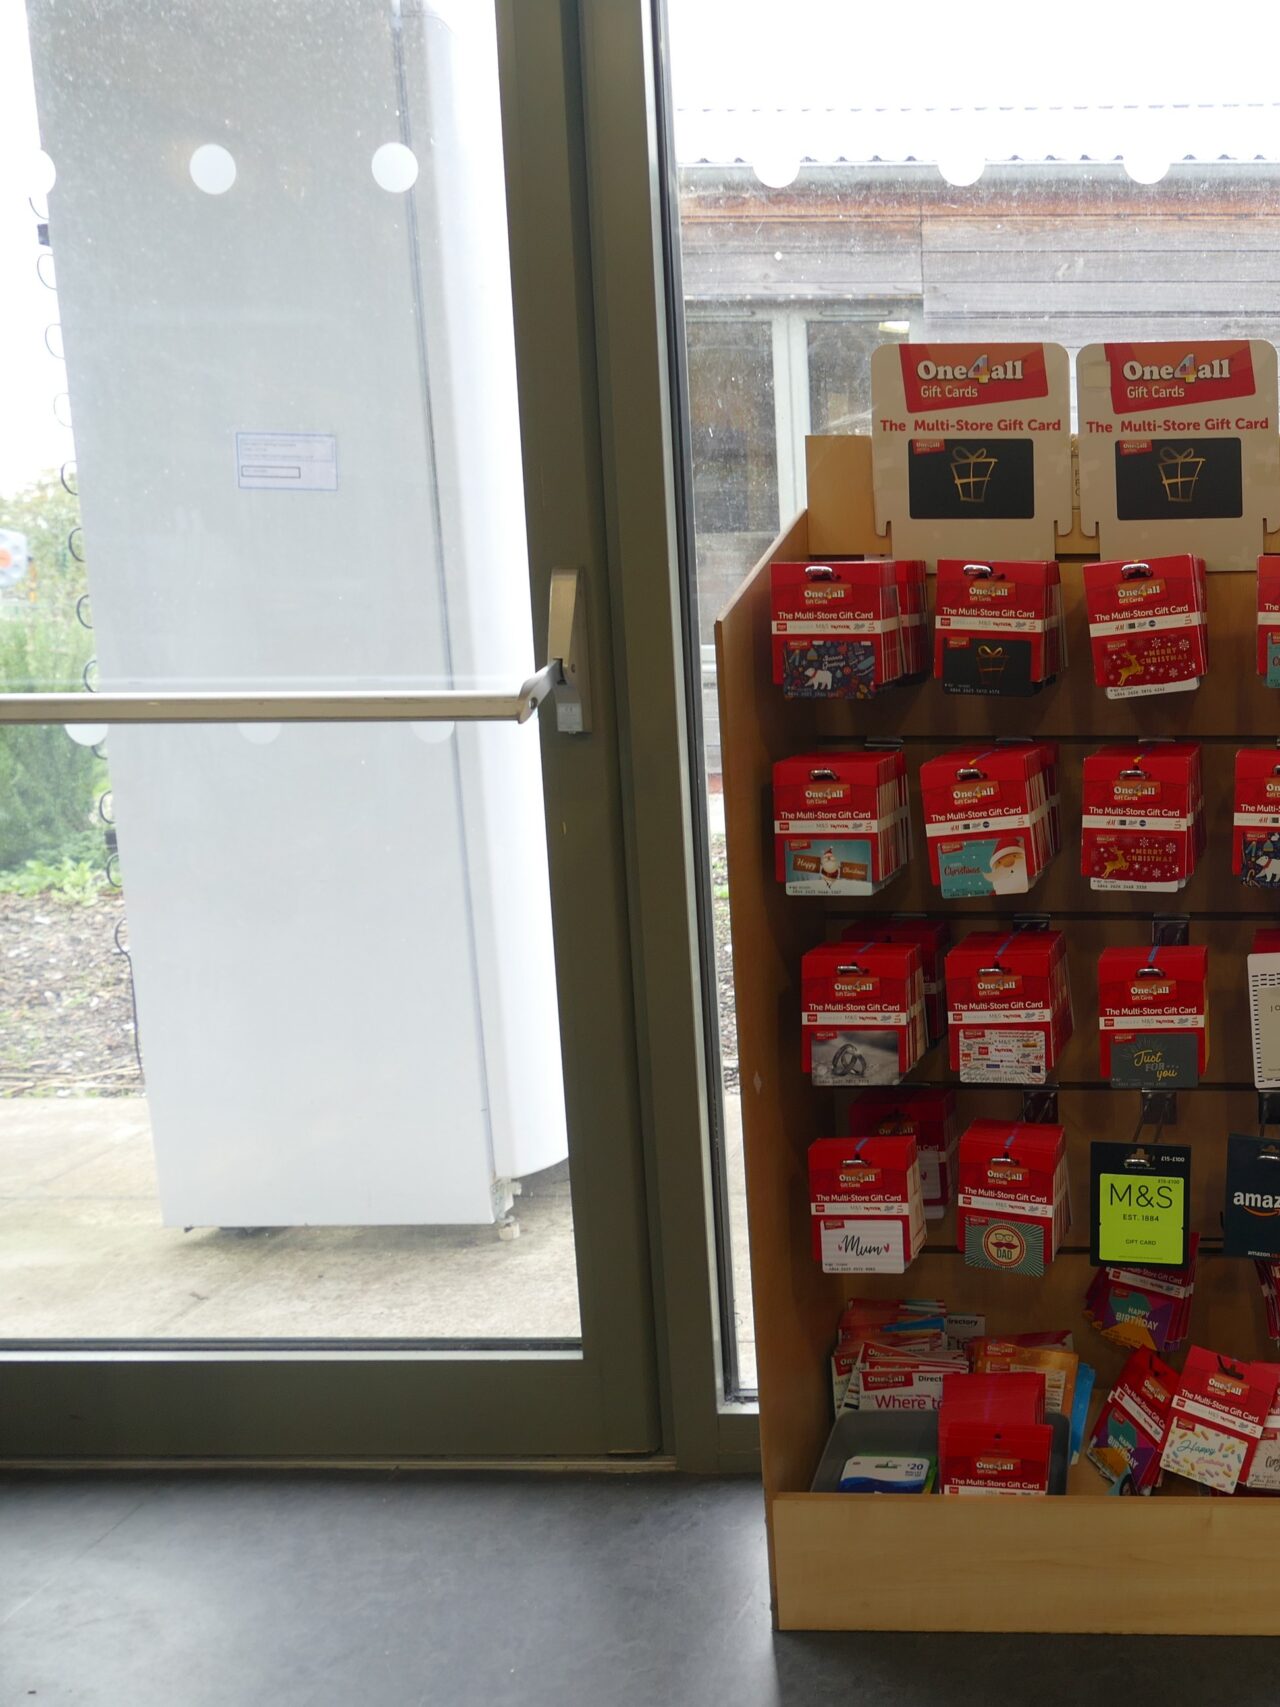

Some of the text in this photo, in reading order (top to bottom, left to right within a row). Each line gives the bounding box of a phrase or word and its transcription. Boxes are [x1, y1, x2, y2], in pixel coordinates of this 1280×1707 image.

[917, 354, 1023, 384] One4all
[1123, 354, 1230, 383] One4all
[921, 385, 978, 398] Gift Cards
[1127, 385, 1184, 398] Gift Cards
[880, 419, 1061, 431] The Multi-Store Gift Card
[1087, 418, 1268, 433] The Multi-Store Gift Card
[795, 612, 837, 620] Multi-Store
[839, 611, 853, 620] Gift
[1095, 605, 1188, 622] The Multi-Store Gift Card
[1141, 654, 1187, 665] CHRISTMAS
[1134, 1050, 1162, 1066] Just
[1156, 1069, 1177, 1079] you
[1109, 1183, 1173, 1208] M&S
[1141, 1214, 1159, 1222] 1884
[842, 1235, 883, 1257] Mum
[996, 1249, 1012, 1259] DAD
[1128, 1307, 1149, 1317] HAPPY
[1116, 1313, 1158, 1330] BIRTHDAY
[876, 1395, 926, 1409] Where
[1177, 1440, 1215, 1455] Happy
